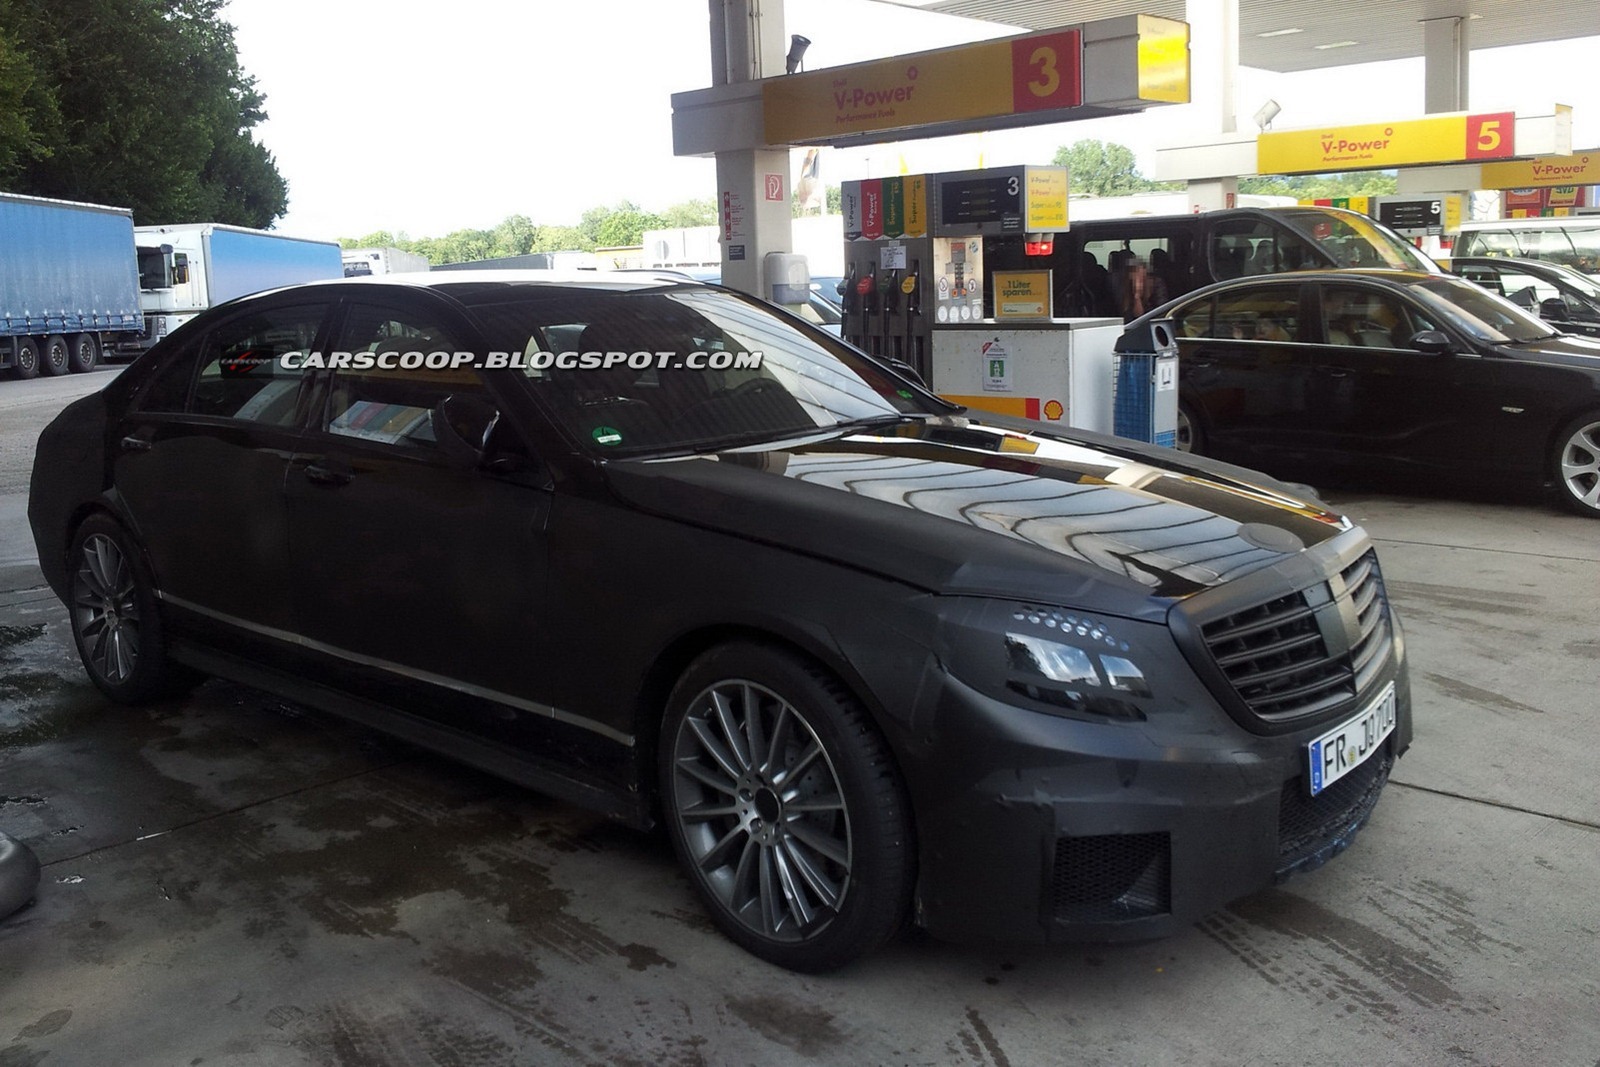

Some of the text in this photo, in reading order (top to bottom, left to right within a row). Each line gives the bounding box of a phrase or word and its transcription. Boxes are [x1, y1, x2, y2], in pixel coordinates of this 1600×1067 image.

[1028, 47, 1060, 97] 3
[834, 86, 914, 110] V-Power
[1477, 121, 1501, 151] 5
[1321, 139, 1390, 154] V-Power
[1532, 165, 1587, 175] V-Power
[1007, 176, 1019, 196] 3
[1430, 202, 1441, 214] 5
[1002, 288, 1032, 298] sparen
[1012, 280, 1031, 289] Liter
[1323, 733, 1347, 780] FR
